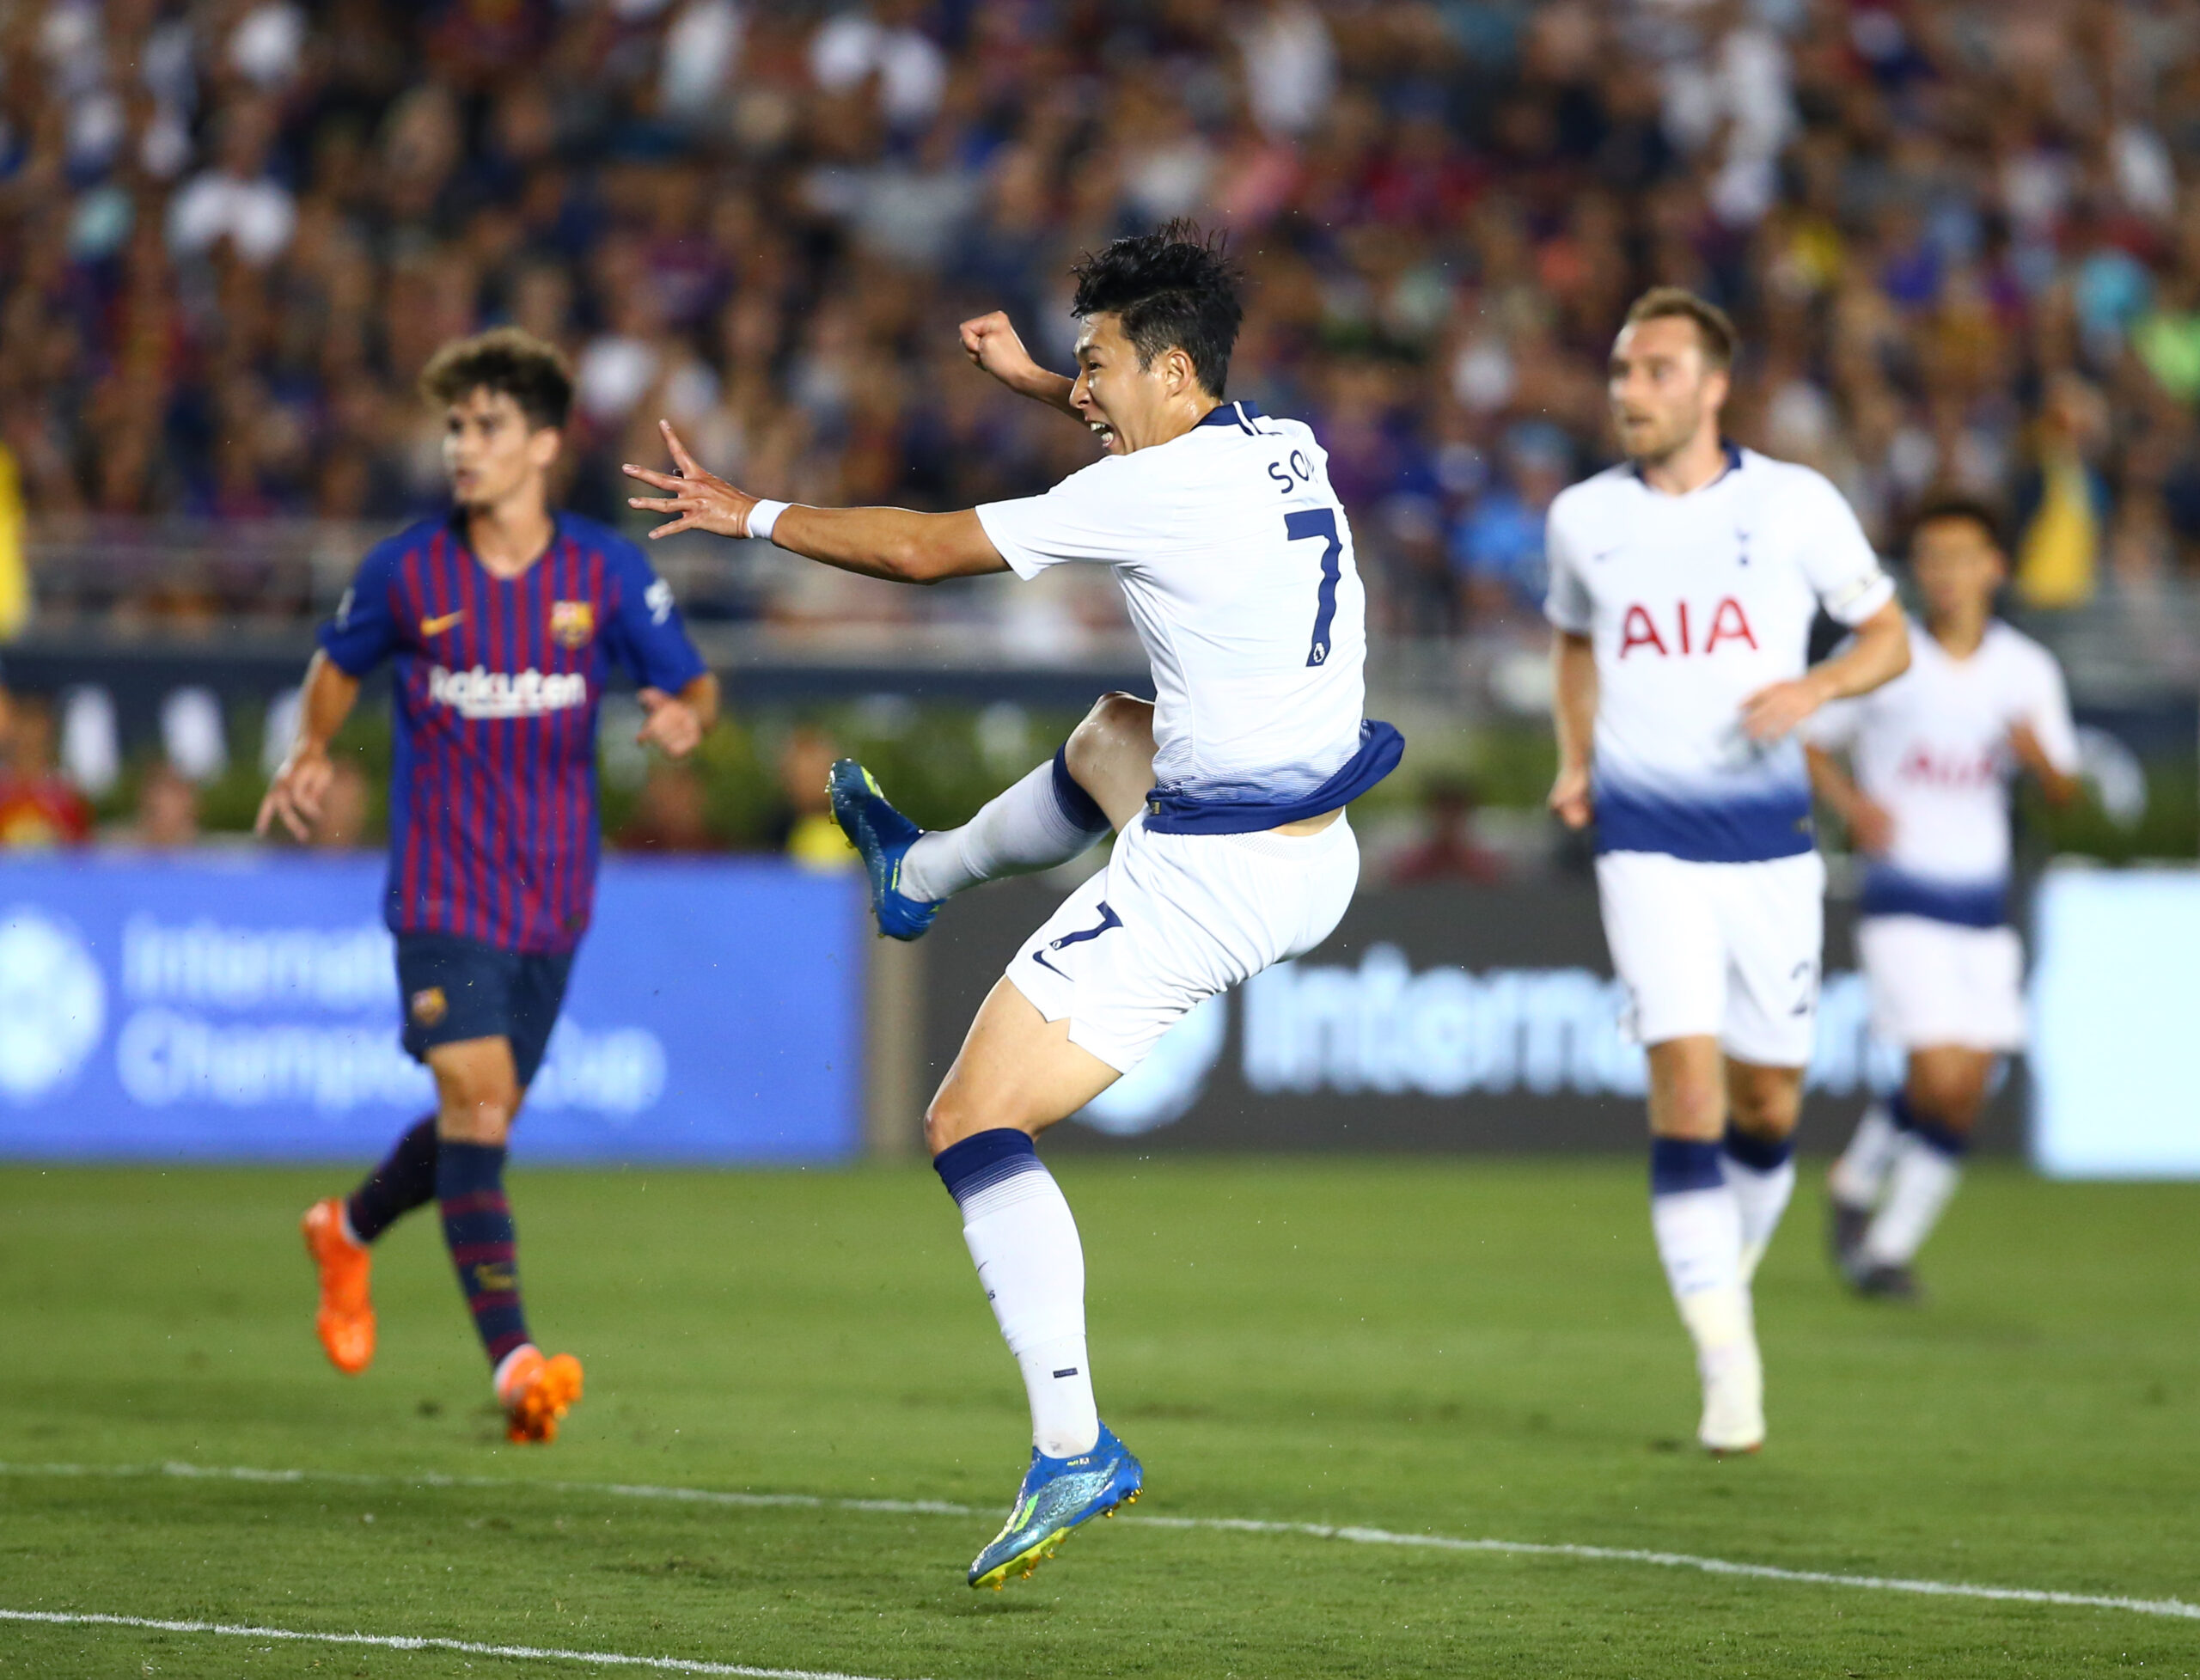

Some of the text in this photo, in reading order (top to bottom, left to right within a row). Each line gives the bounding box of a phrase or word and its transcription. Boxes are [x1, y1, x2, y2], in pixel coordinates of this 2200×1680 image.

[1284, 508, 1342, 668] 7
[1619, 596, 1759, 659] AIA
[1049, 901, 1123, 950] 7
